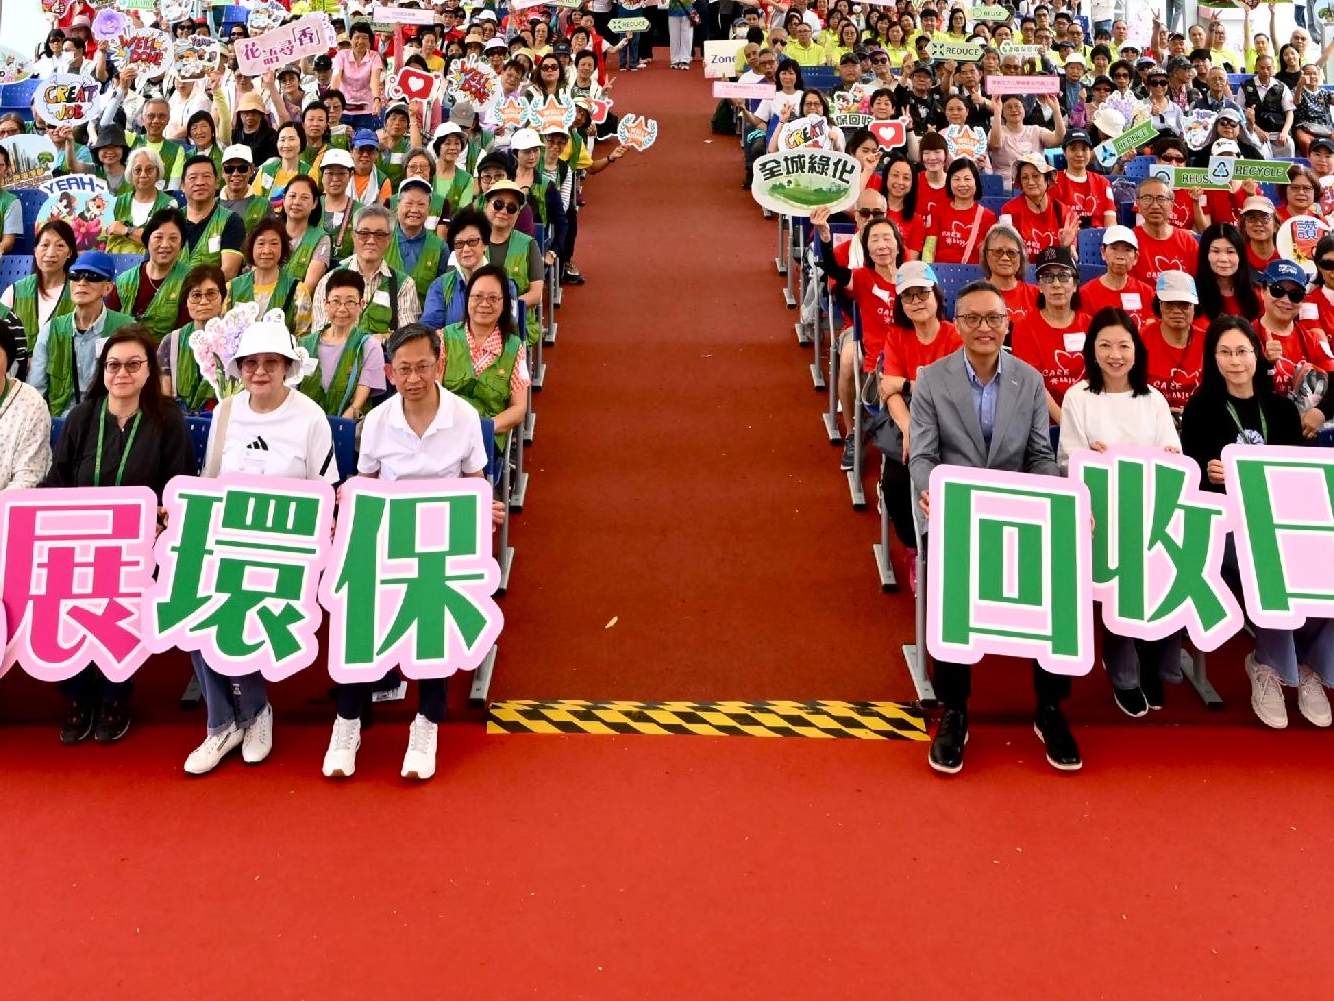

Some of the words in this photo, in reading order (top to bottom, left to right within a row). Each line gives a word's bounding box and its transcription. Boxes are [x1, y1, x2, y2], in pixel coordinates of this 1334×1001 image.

[118, 34, 156, 51] WELL
[130, 50, 164, 66] DONE
[946, 47, 979, 56] REDUCE
[45, 84, 99, 104] GREAT
[55, 104, 84, 120] JOB
[835, 115, 874, 126] 保回收
[785, 119, 825, 149] GREAT
[1117, 128, 1150, 150] REDUCE
[758, 153, 856, 185] 全城綠化
[1235, 165, 1285, 177] RECYCLE
[1182, 174, 1214, 184] REUS
[1298, 220, 1319, 240] 讚
[1043, 368, 1070, 377] CARE
